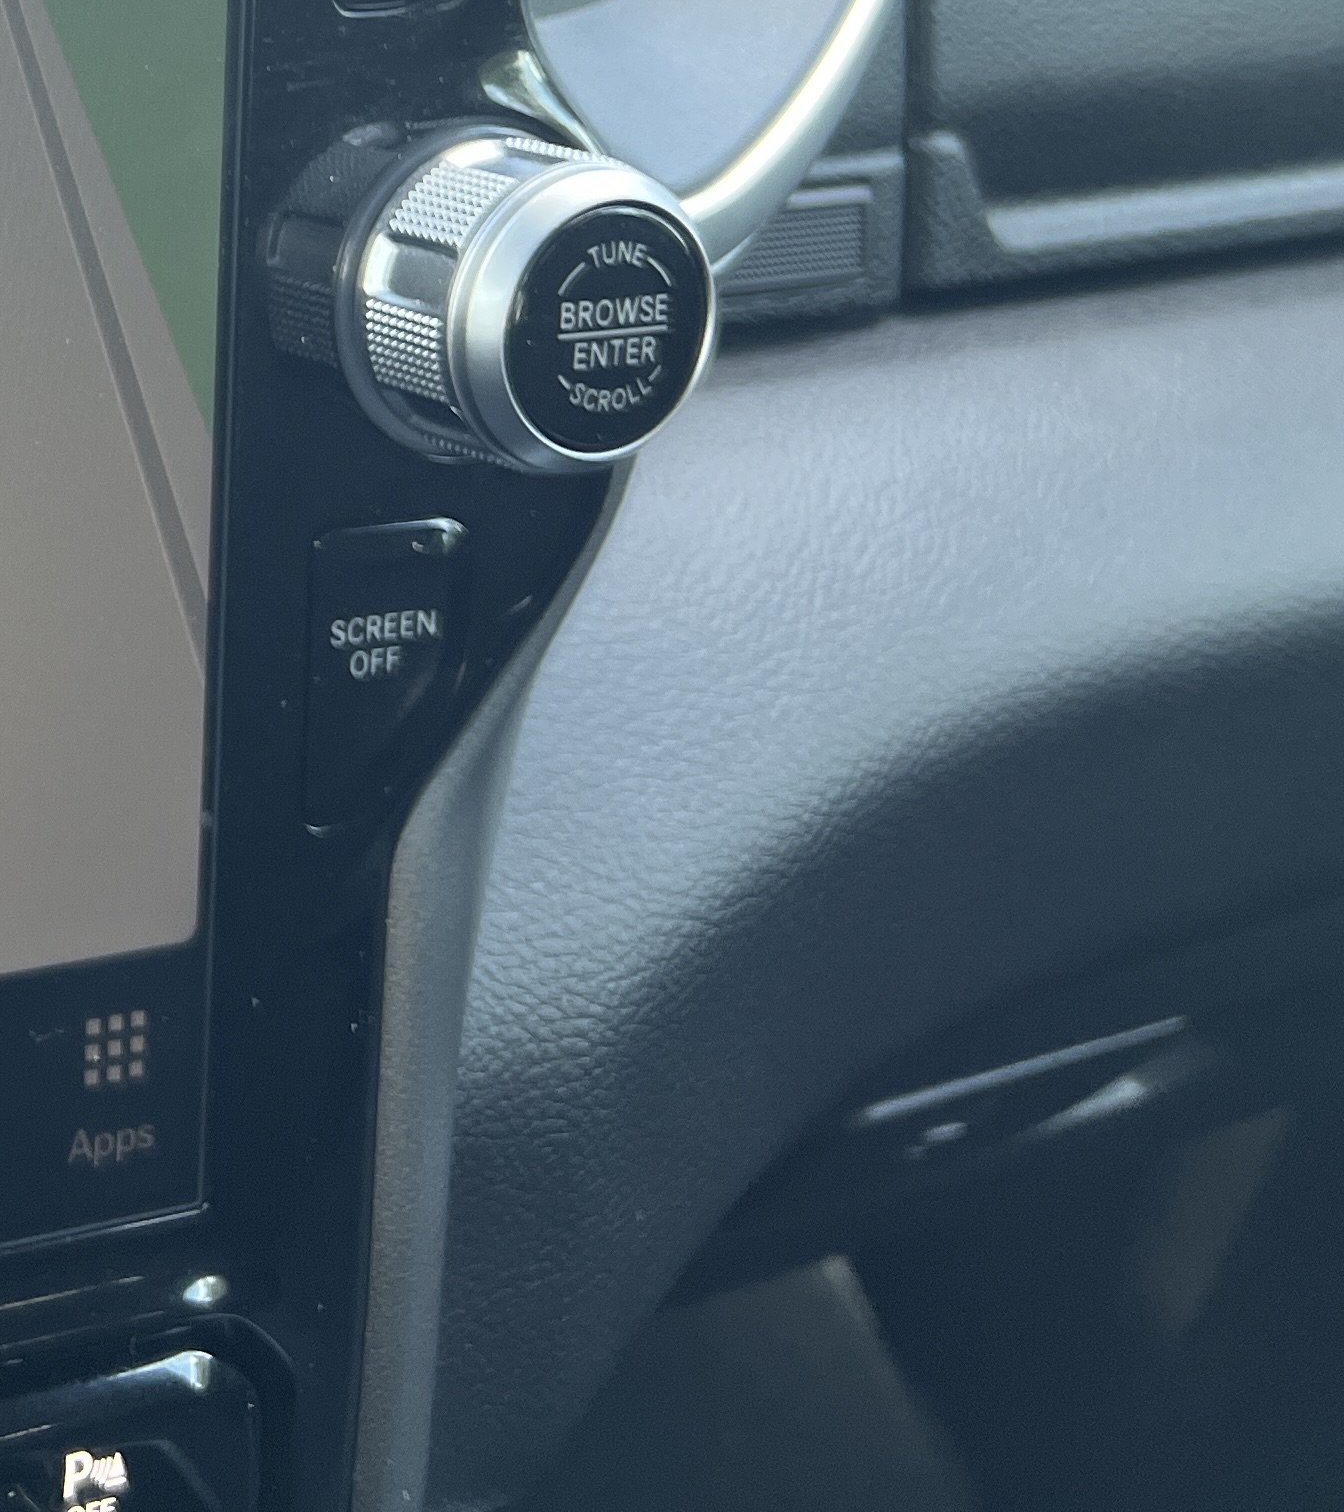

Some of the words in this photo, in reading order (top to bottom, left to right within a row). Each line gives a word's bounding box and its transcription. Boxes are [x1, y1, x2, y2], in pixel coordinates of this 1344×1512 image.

[587, 240, 650, 270] TUNE
[559, 292, 670, 331] BROWSE
[573, 335, 657, 372] ENTER
[568, 380, 653, 412] SCROLL
[330, 608, 439, 648] SCREEN
[349, 645, 402, 679] OFF
[67, 1119, 156, 1170] Apps
